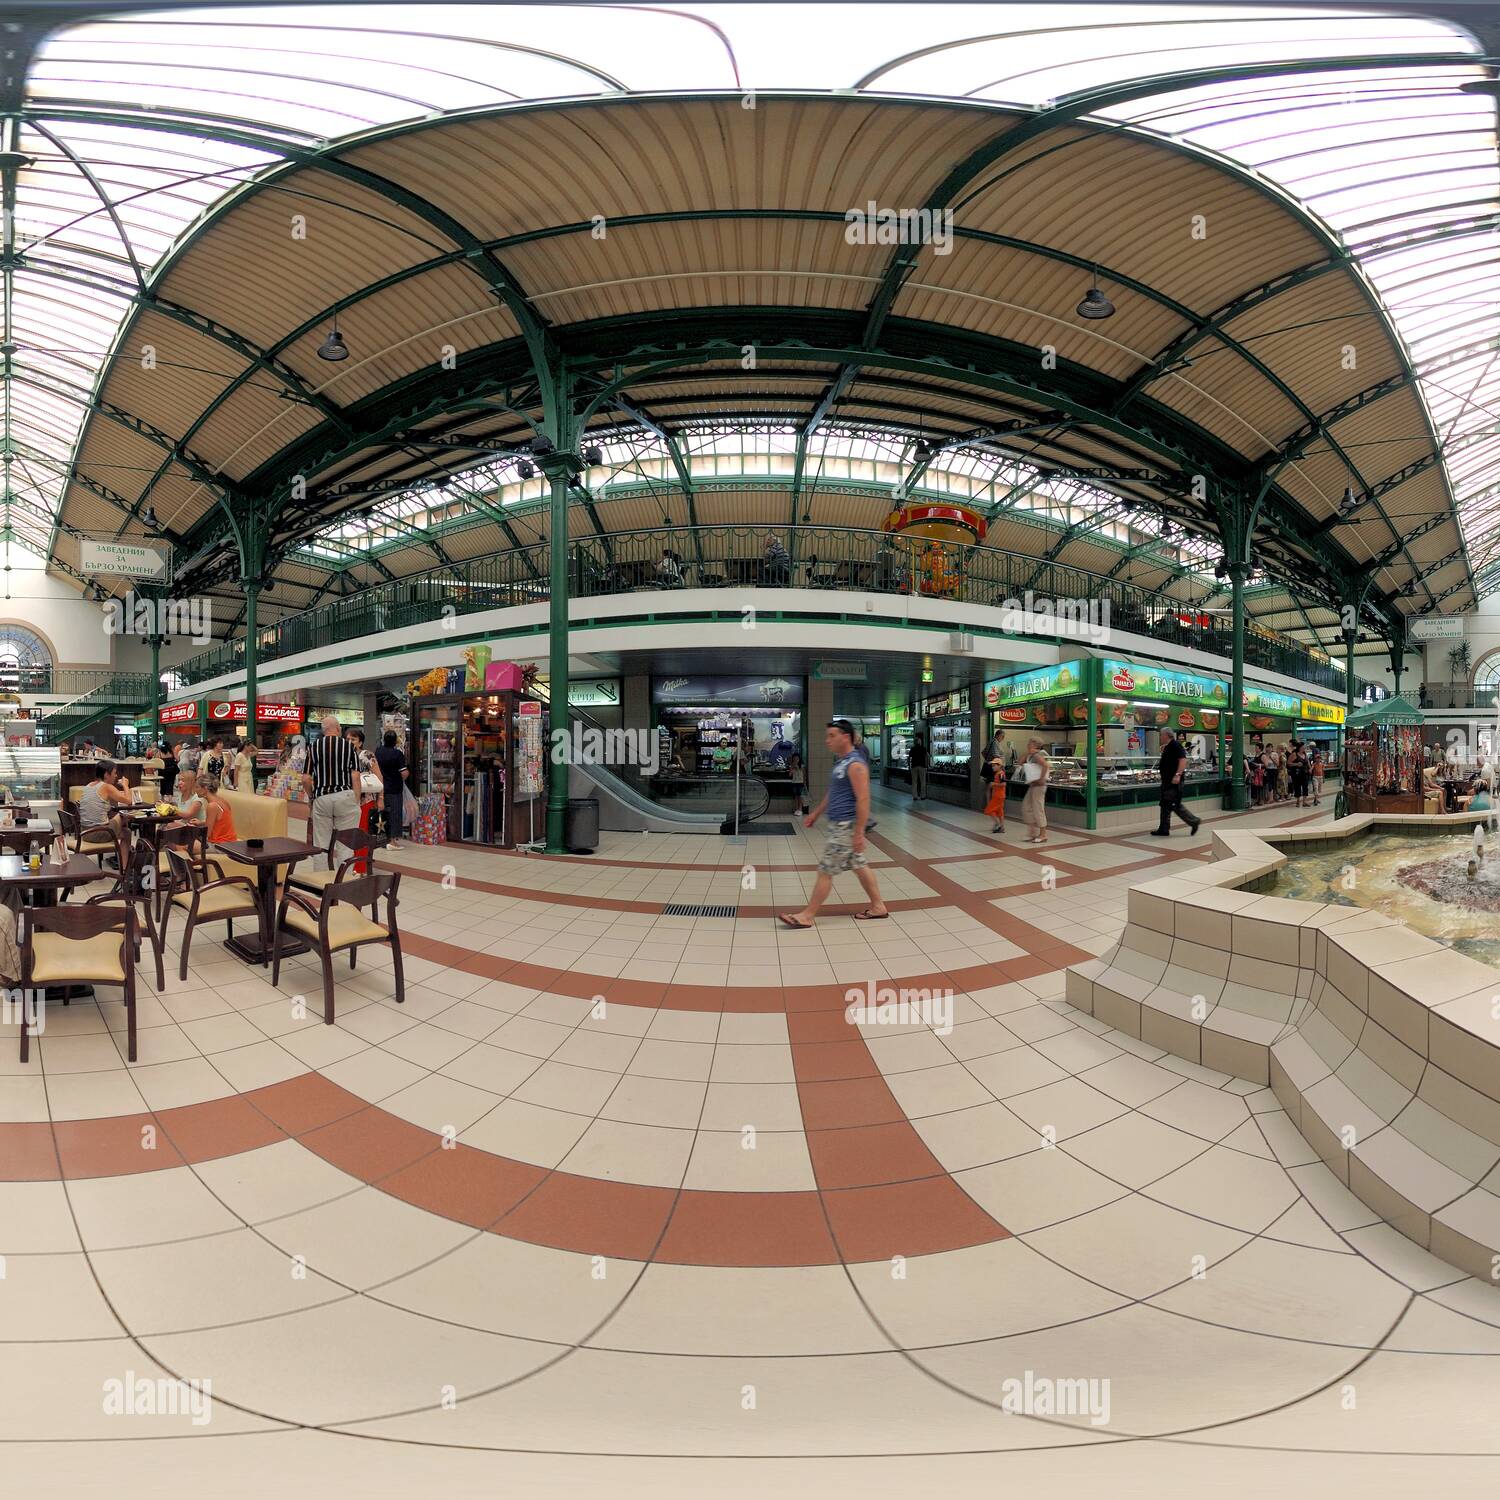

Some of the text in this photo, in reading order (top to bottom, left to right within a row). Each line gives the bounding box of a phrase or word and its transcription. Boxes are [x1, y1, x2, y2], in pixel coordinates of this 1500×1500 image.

[96, 545, 145, 556] ЗАВЕДЕНИЯ
[85, 561, 155, 575] БЪРЗО ХРАНЕНЕ
[662, 678, 689, 692] Milka
[1006, 676, 1050, 699] ТАНДЕМ
[1113, 679, 1135, 688] ТАНДЕМ
[1153, 676, 1204, 698] ТАНДЕМ
[1258, 695, 1288, 711] ТАНДЕМ
[1001, 710, 1025, 718] ТАНДЕМ
